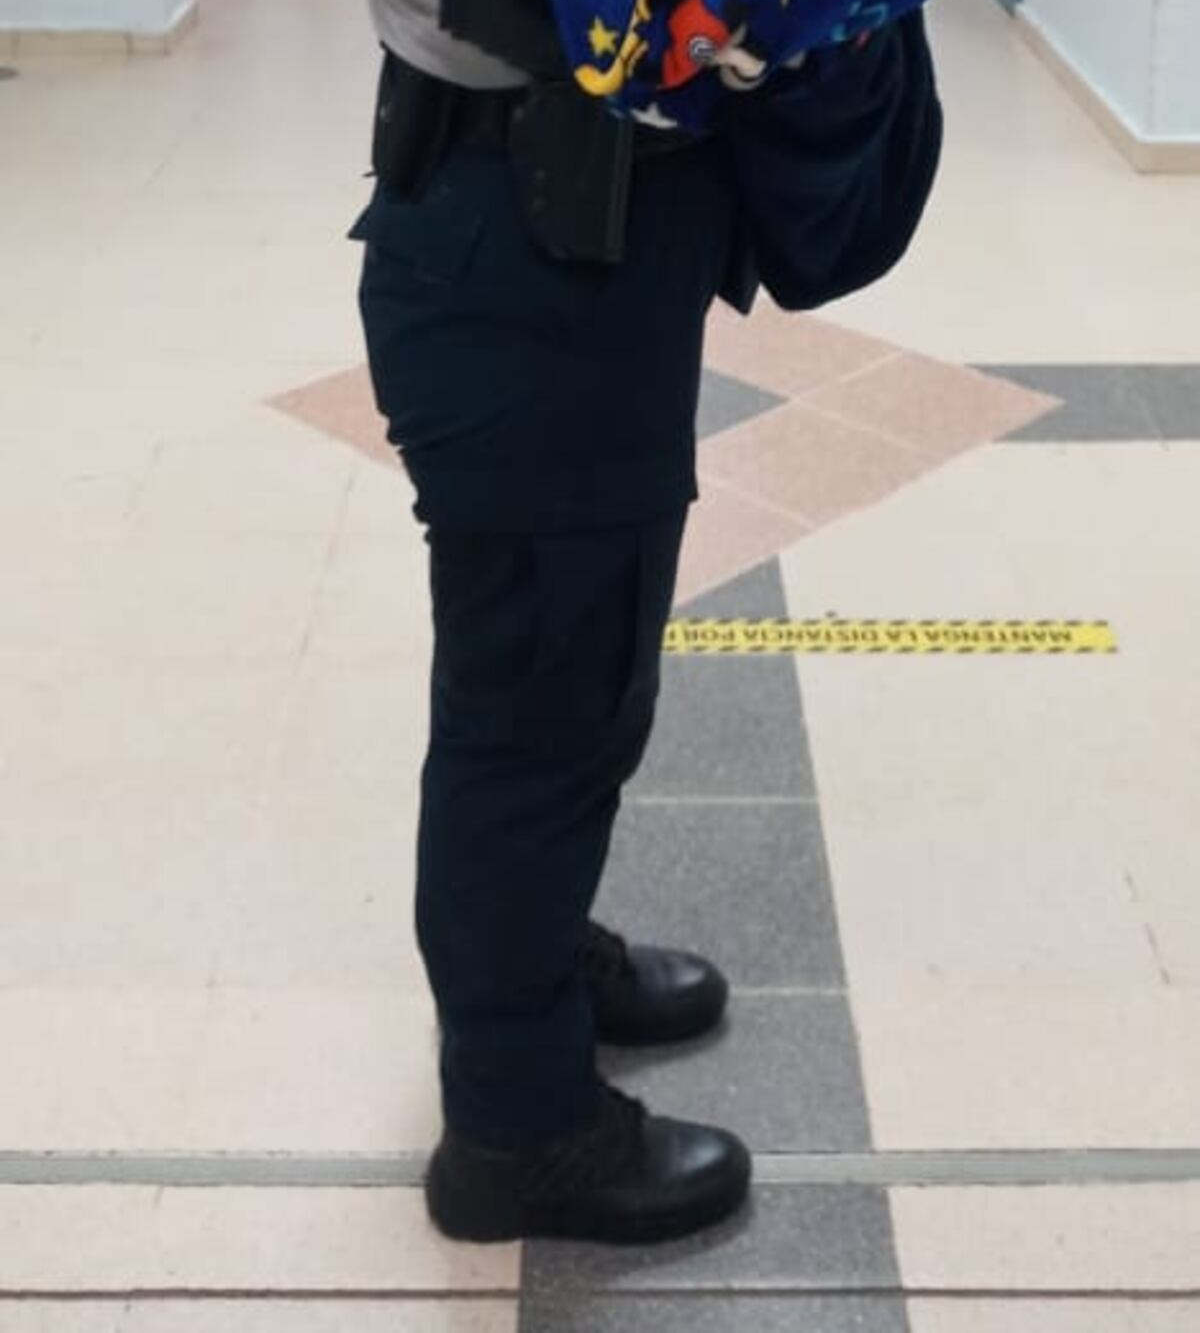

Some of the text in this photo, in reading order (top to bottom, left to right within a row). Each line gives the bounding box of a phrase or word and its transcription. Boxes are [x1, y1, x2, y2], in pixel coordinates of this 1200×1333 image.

[684, 627, 736, 642] POR
[742, 627, 879, 642] DISTANCIA
[885, 628, 918, 642] LA
[923, 628, 1073, 642] MANTENGA
